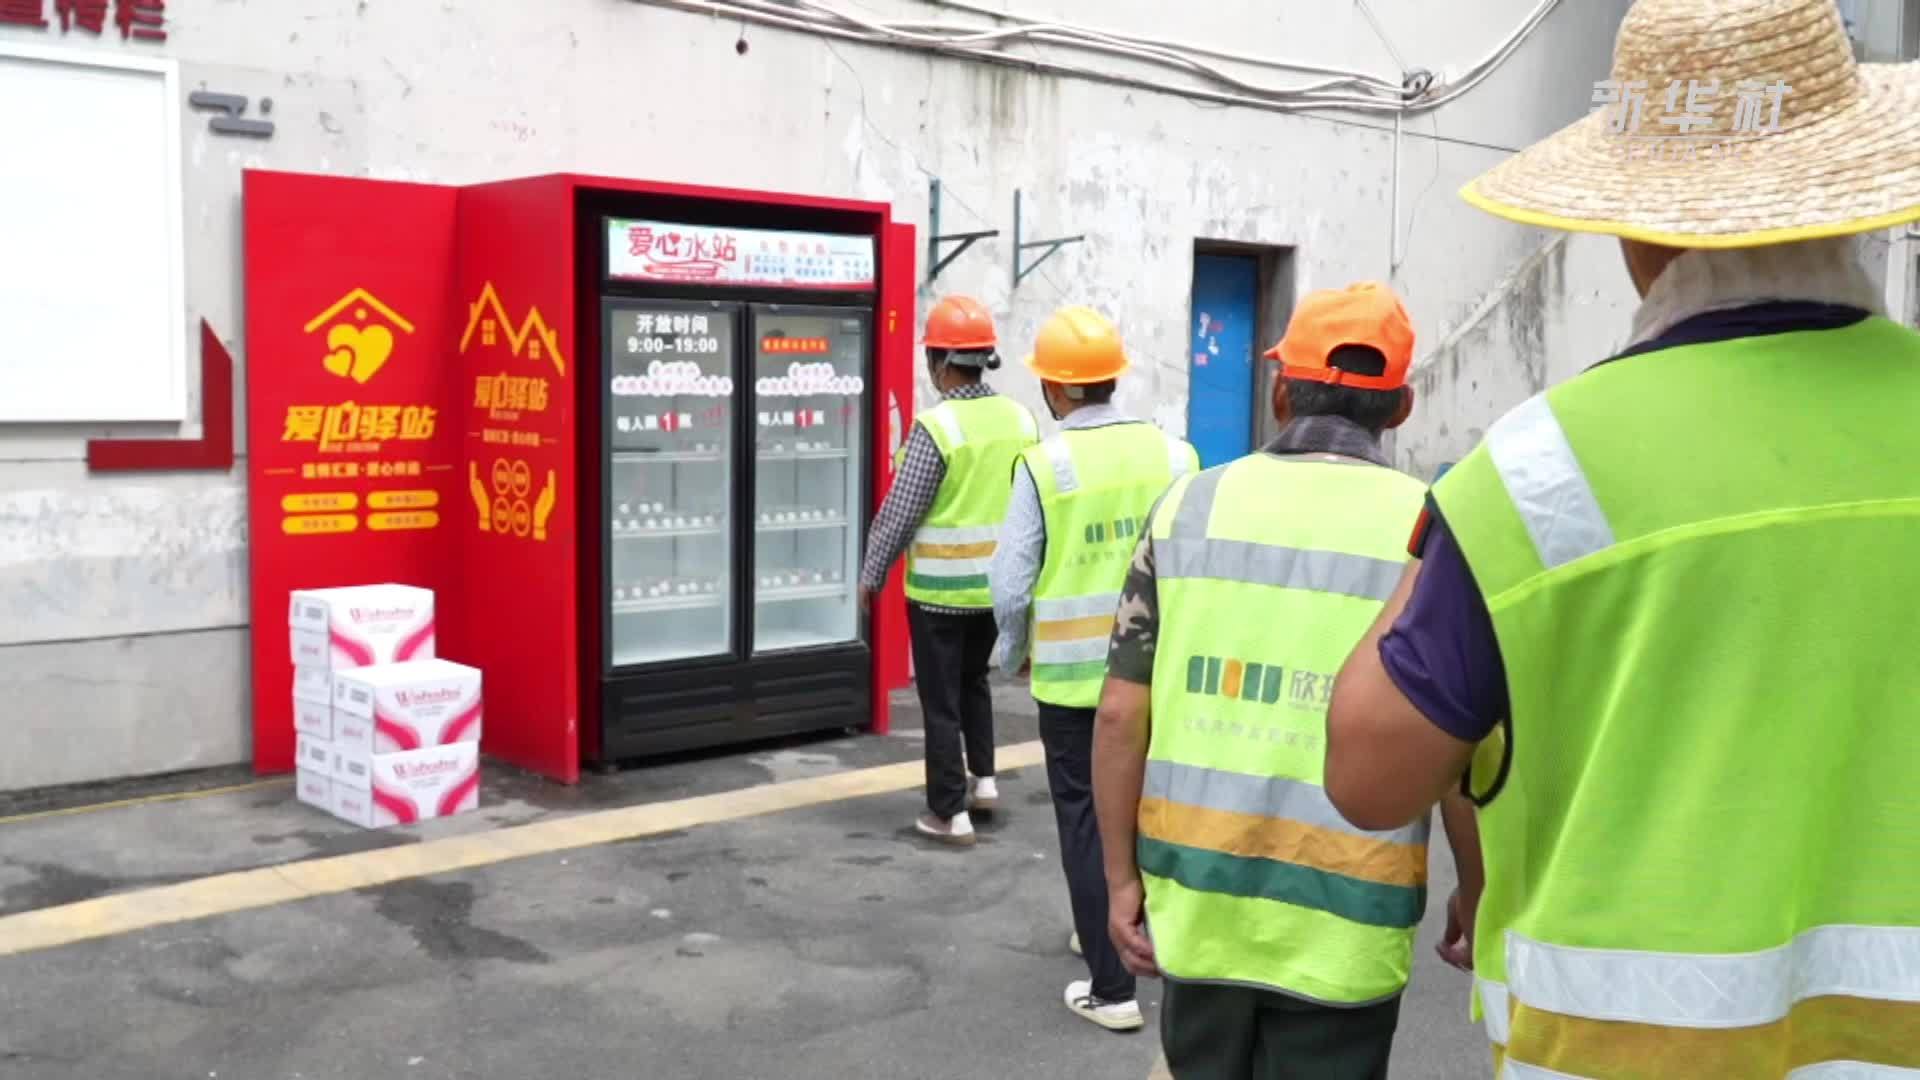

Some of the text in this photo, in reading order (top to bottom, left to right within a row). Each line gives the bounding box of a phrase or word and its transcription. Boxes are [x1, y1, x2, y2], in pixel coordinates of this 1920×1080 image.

[628, 226, 737, 262] 爱心水站
[636, 314, 709, 335] 开放时间
[627, 336, 719, 353] 9:00-19:00
[280, 400, 439, 451] 爱心驿站
